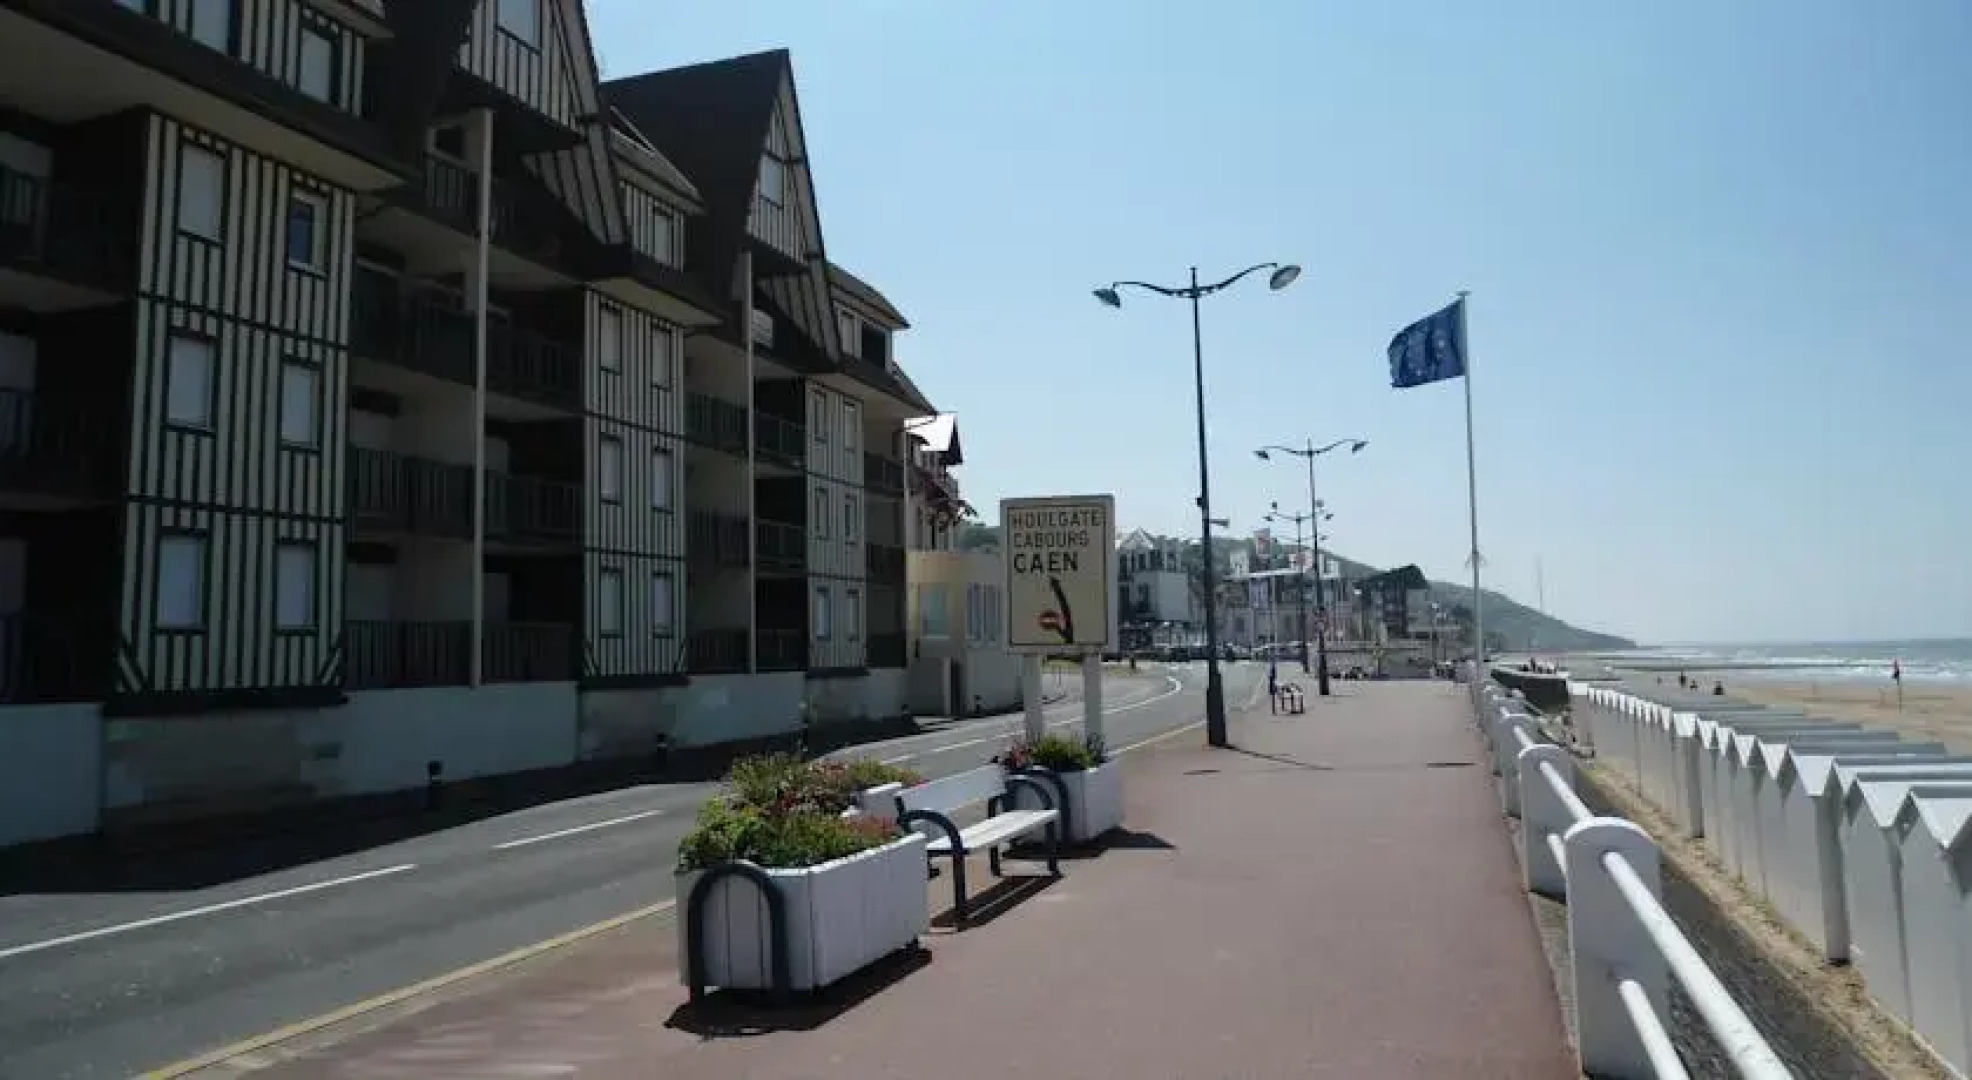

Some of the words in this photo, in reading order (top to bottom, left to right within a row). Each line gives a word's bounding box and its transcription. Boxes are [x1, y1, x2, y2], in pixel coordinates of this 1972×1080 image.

[1012, 510, 1102, 528] HOULGATE
[1013, 530, 1090, 548] CABOURG
[1013, 551, 1079, 574] CAEN
